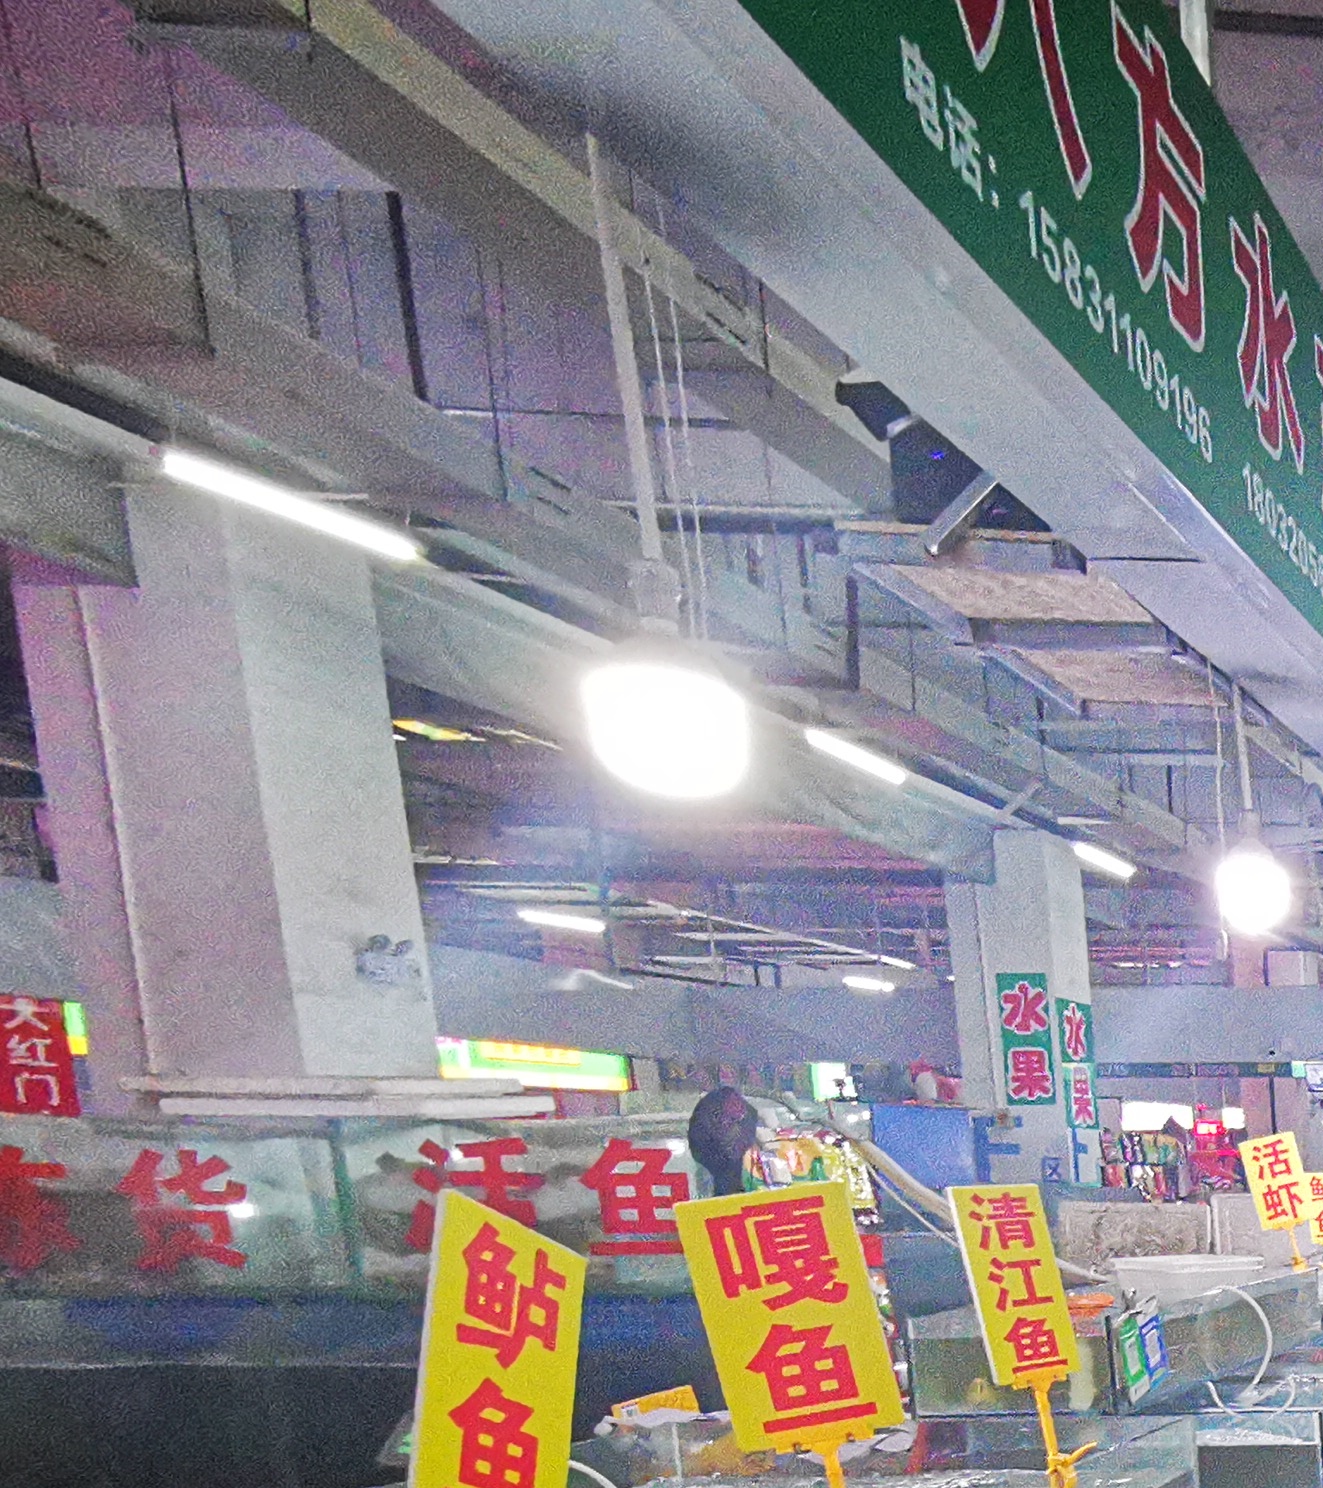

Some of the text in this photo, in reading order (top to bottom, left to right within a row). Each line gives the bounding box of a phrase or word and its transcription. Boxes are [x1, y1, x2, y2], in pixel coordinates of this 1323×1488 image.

[1001, 981, 1053, 1099] 水果
[1252, 1138, 1305, 1221] 活虾
[704, 1194, 879, 1434] 嘎鱼
[970, 1192, 1070, 1375] 清江鱼
